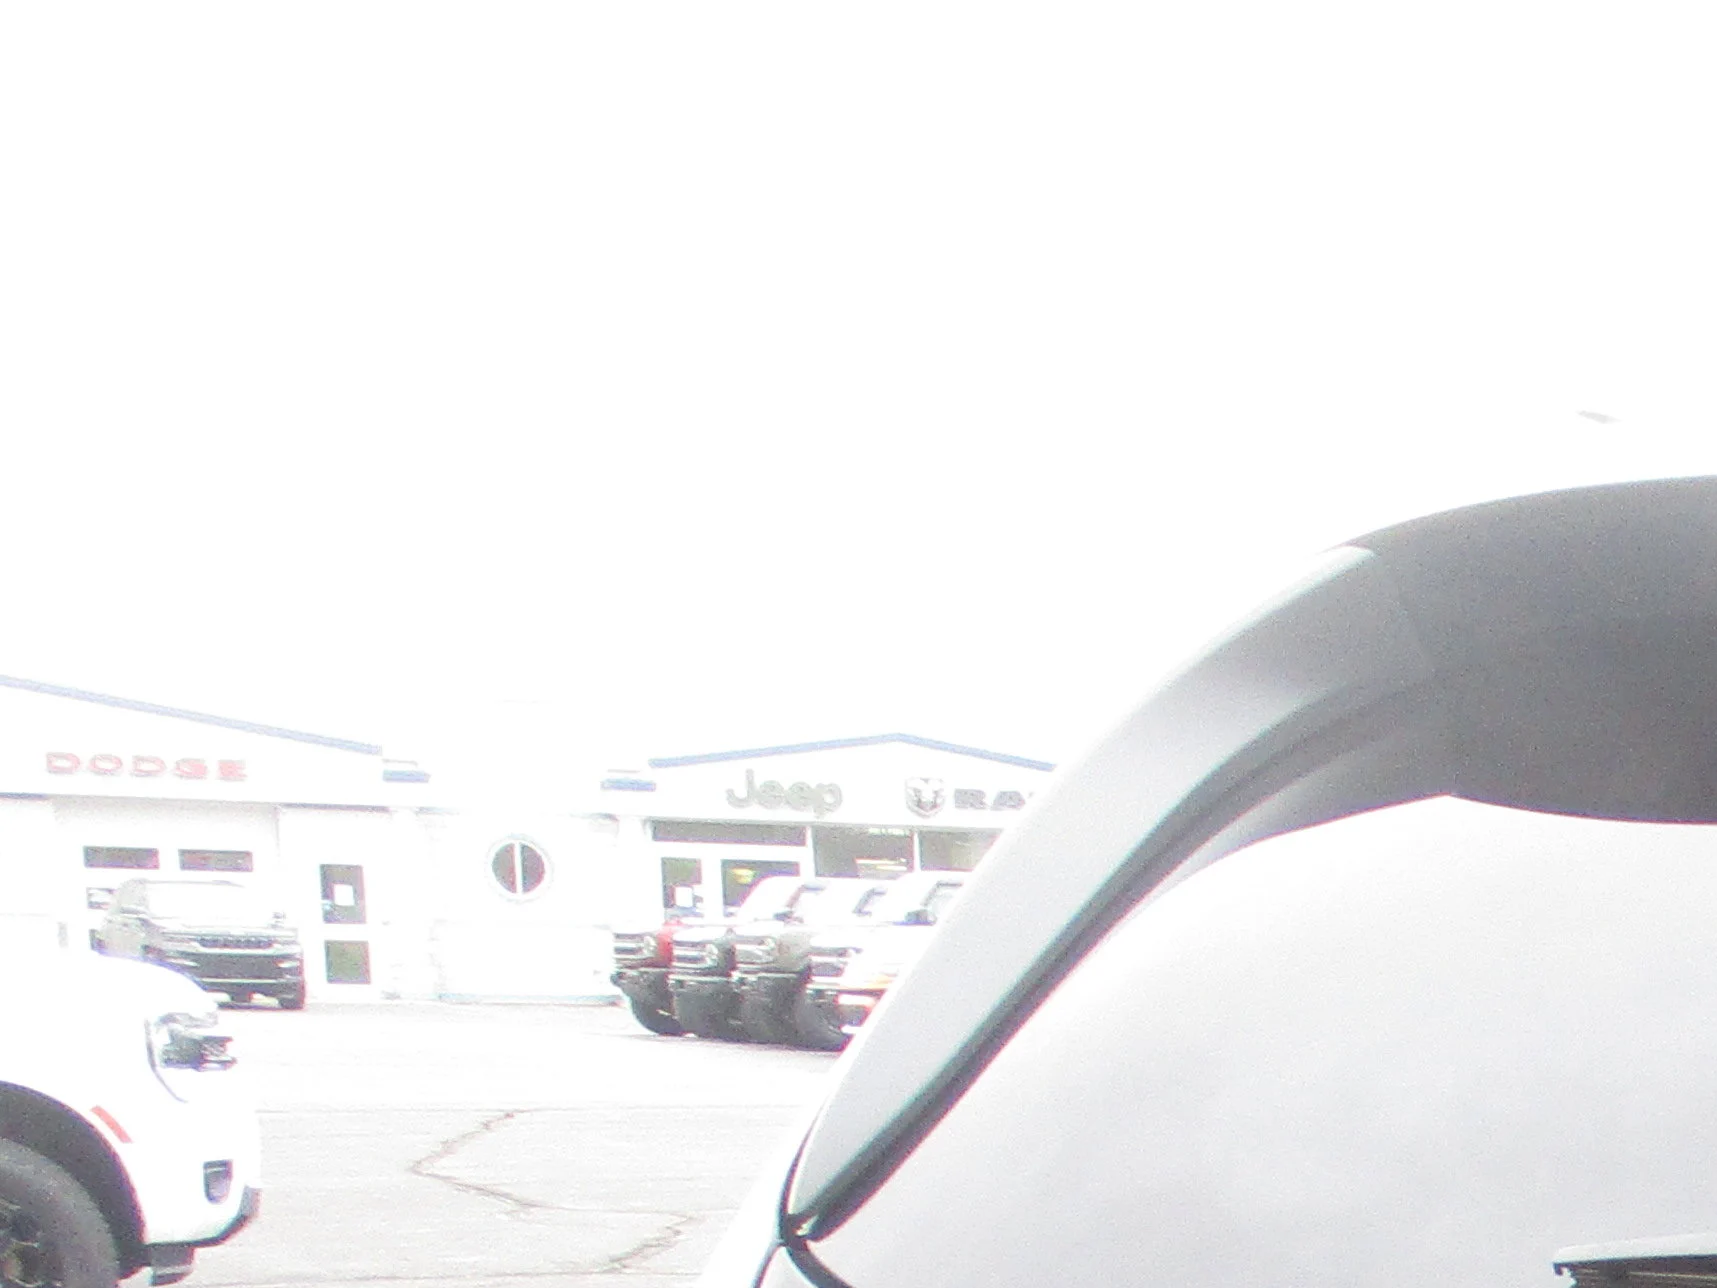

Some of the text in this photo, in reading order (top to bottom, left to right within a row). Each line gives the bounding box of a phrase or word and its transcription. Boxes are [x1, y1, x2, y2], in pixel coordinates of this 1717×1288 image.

[45, 751, 247, 781] DODGE
[725, 768, 843, 819] Jeep
[954, 788, 1034, 811] RA
